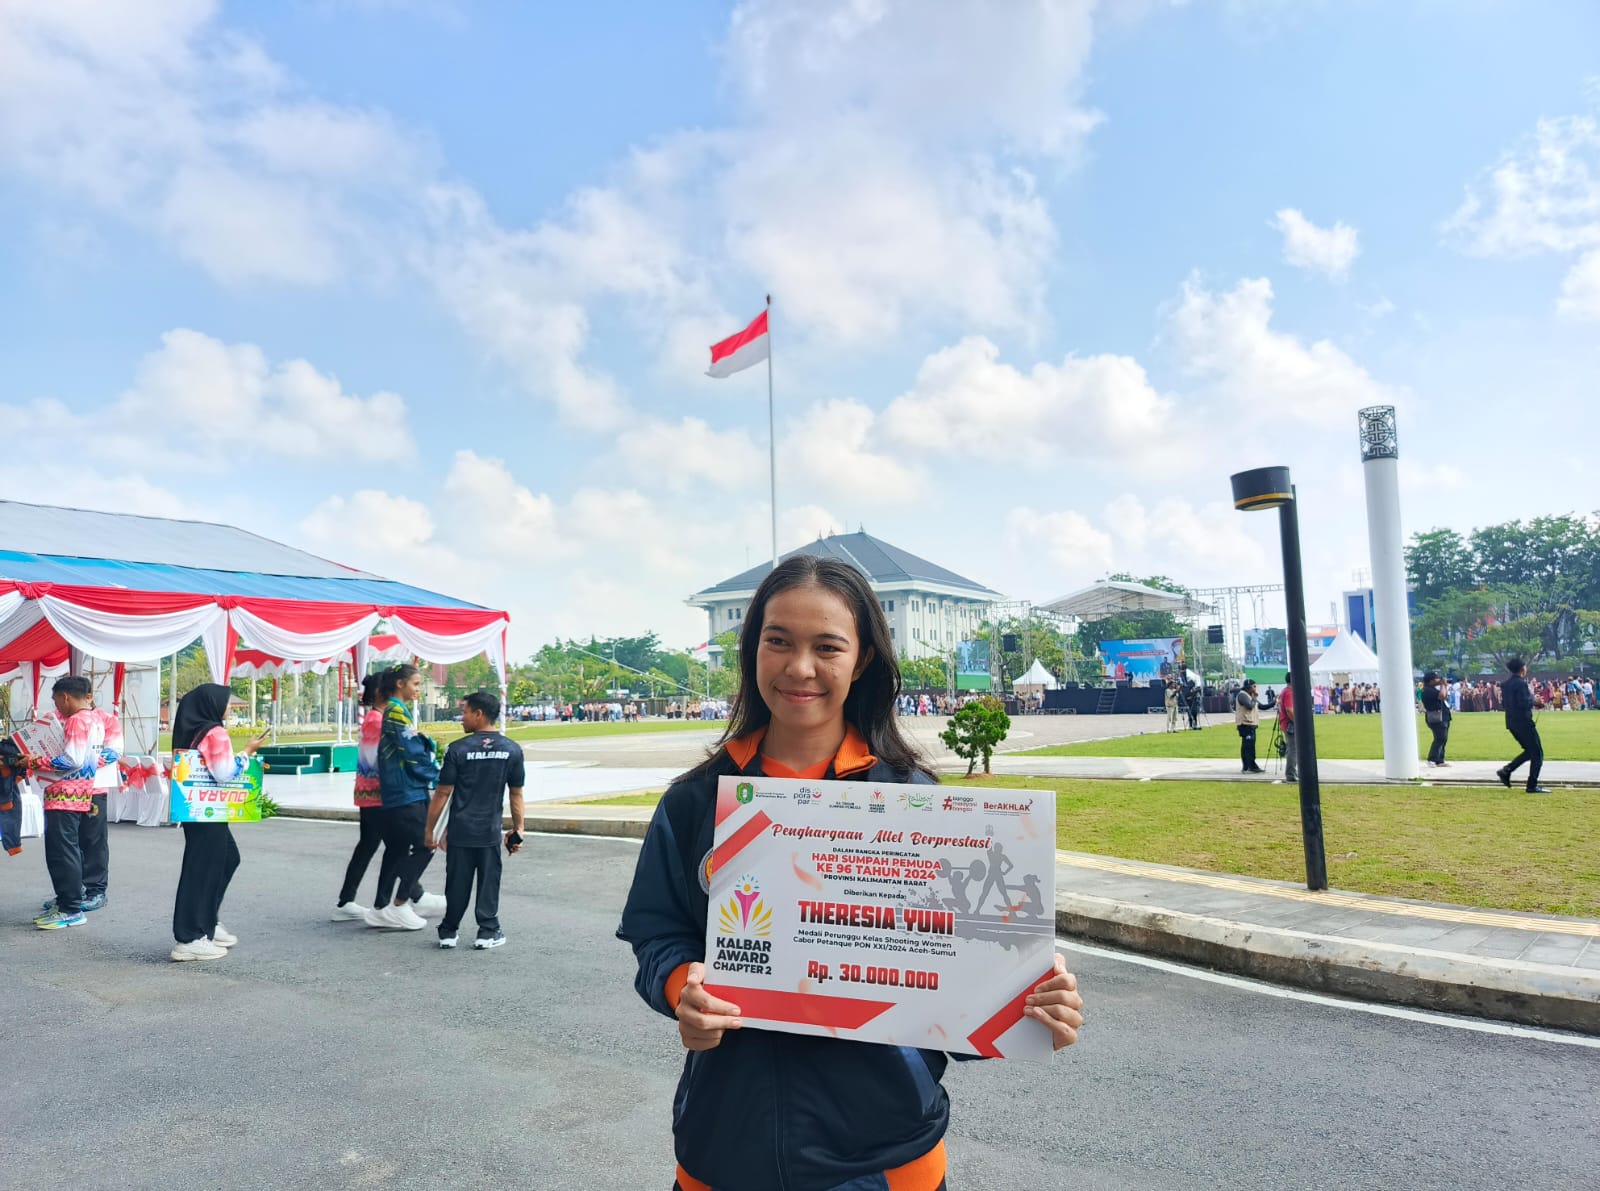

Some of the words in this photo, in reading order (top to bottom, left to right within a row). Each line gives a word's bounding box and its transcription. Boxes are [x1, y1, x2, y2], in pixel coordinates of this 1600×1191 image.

[466, 751, 510, 760] KALBAR
[984, 802, 1031, 812] BerAKHLAK
[772, 824, 864, 841] Penghargaan
[910, 832, 992, 849] Berprestasi
[812, 853, 839, 862] HARI
[841, 855, 889, 866] SUMPAH
[892, 859, 942, 870] PEMUDA
[816, 863, 833, 872] KE
[836, 864, 852, 873] 96
[856, 866, 900, 877] TAHUN
[904, 869, 937, 880] 2024
[824, 874, 856, 882] PROVINSI
[856, 877, 902, 885] KALIMANTAN
[843, 889, 877, 897] Diberikan
[878, 892, 907, 900] Kepada:
[798, 900, 895, 930] THERESIA
[903, 908, 953, 935] YUNI
[716, 937, 772, 952] KALBAR
[793, 936, 815, 944] Cabor
[816, 938, 852, 949] Petanque
[872, 943, 907, 952] XXI/2024
[908, 946, 957, 957] Aceh-Sumut
[798, 929, 823, 937] Medali
[824, 931, 861, 942] Perunggu
[862, 935, 883, 943] Kelas
[885, 937, 920, 947] Shooting
[921, 940, 952, 949] Women
[717, 949, 770, 964] AWARD
[713, 961, 763, 974] CHAPTER
[765, 966, 772, 975] 2
[808, 960, 833, 984] Rp.
[839, 963, 939, 991] 30.000.000
